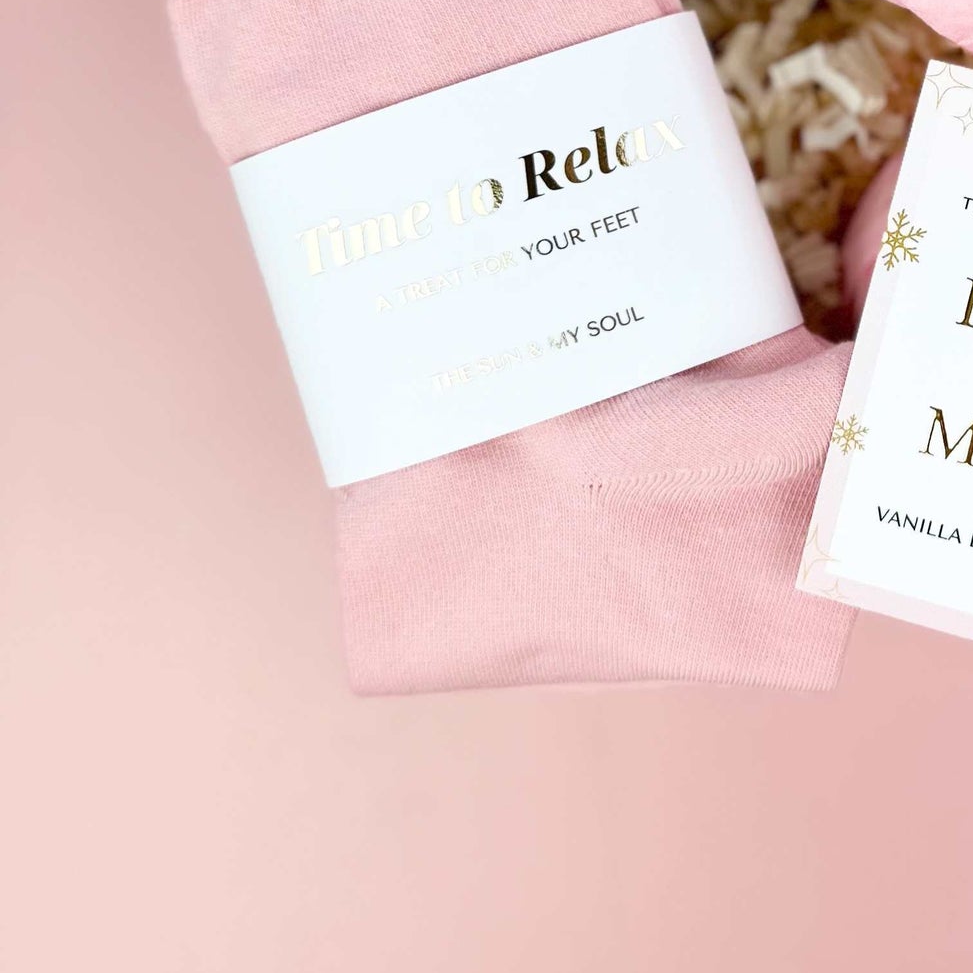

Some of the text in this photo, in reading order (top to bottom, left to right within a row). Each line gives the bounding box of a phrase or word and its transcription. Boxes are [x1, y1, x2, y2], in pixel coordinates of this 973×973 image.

[295, 114, 689, 277] Time to Relax
[392, 267, 464, 305] TREAT
[469, 249, 518, 279] FOR
[520, 228, 586, 261] YOUR
[591, 206, 641, 238] FEET
[548, 326, 580, 349] MY
[587, 307, 645, 337] SOUL
[877, 506, 962, 544] VANILLA
